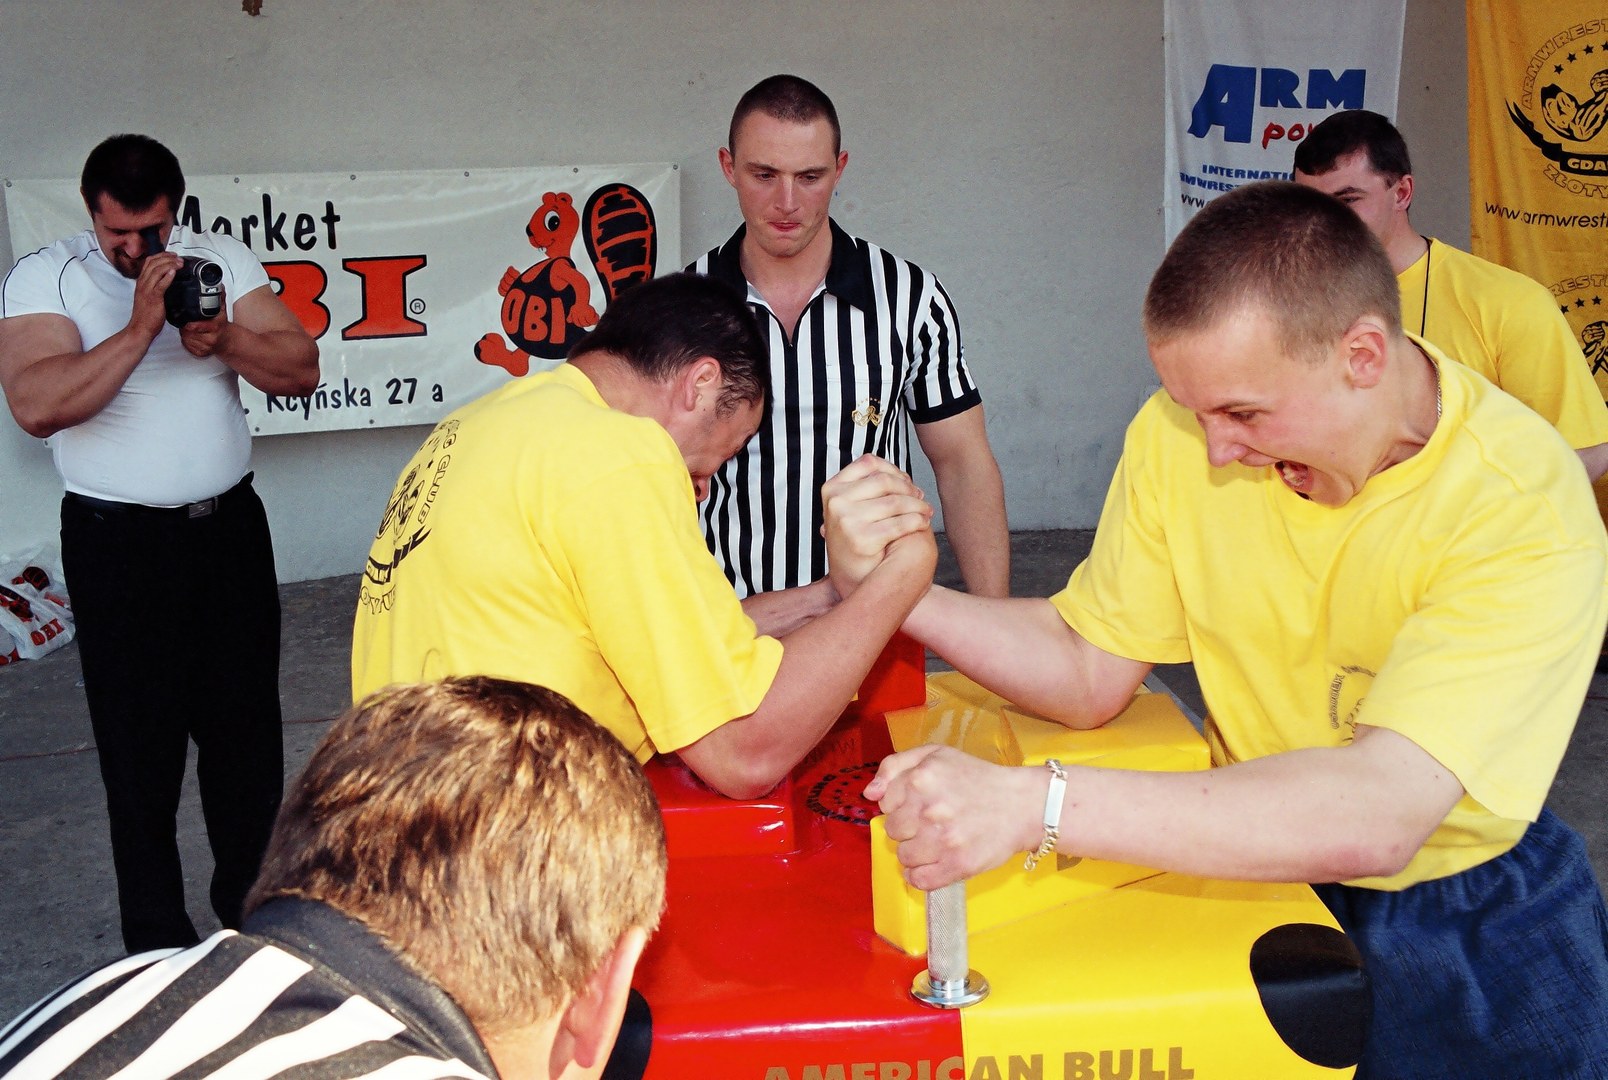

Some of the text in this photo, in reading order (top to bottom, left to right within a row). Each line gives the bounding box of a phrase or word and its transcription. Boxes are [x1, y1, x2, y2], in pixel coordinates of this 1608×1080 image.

[1188, 64, 1366, 143] ARM
[1262, 122, 1317, 149] po
[501, 288, 566, 345] OBI
[385, 377, 418, 405] 27
[432, 383, 444, 403] a
[30, 618, 65, 646] OBI
[1063, 1046, 1195, 1080] BULL
